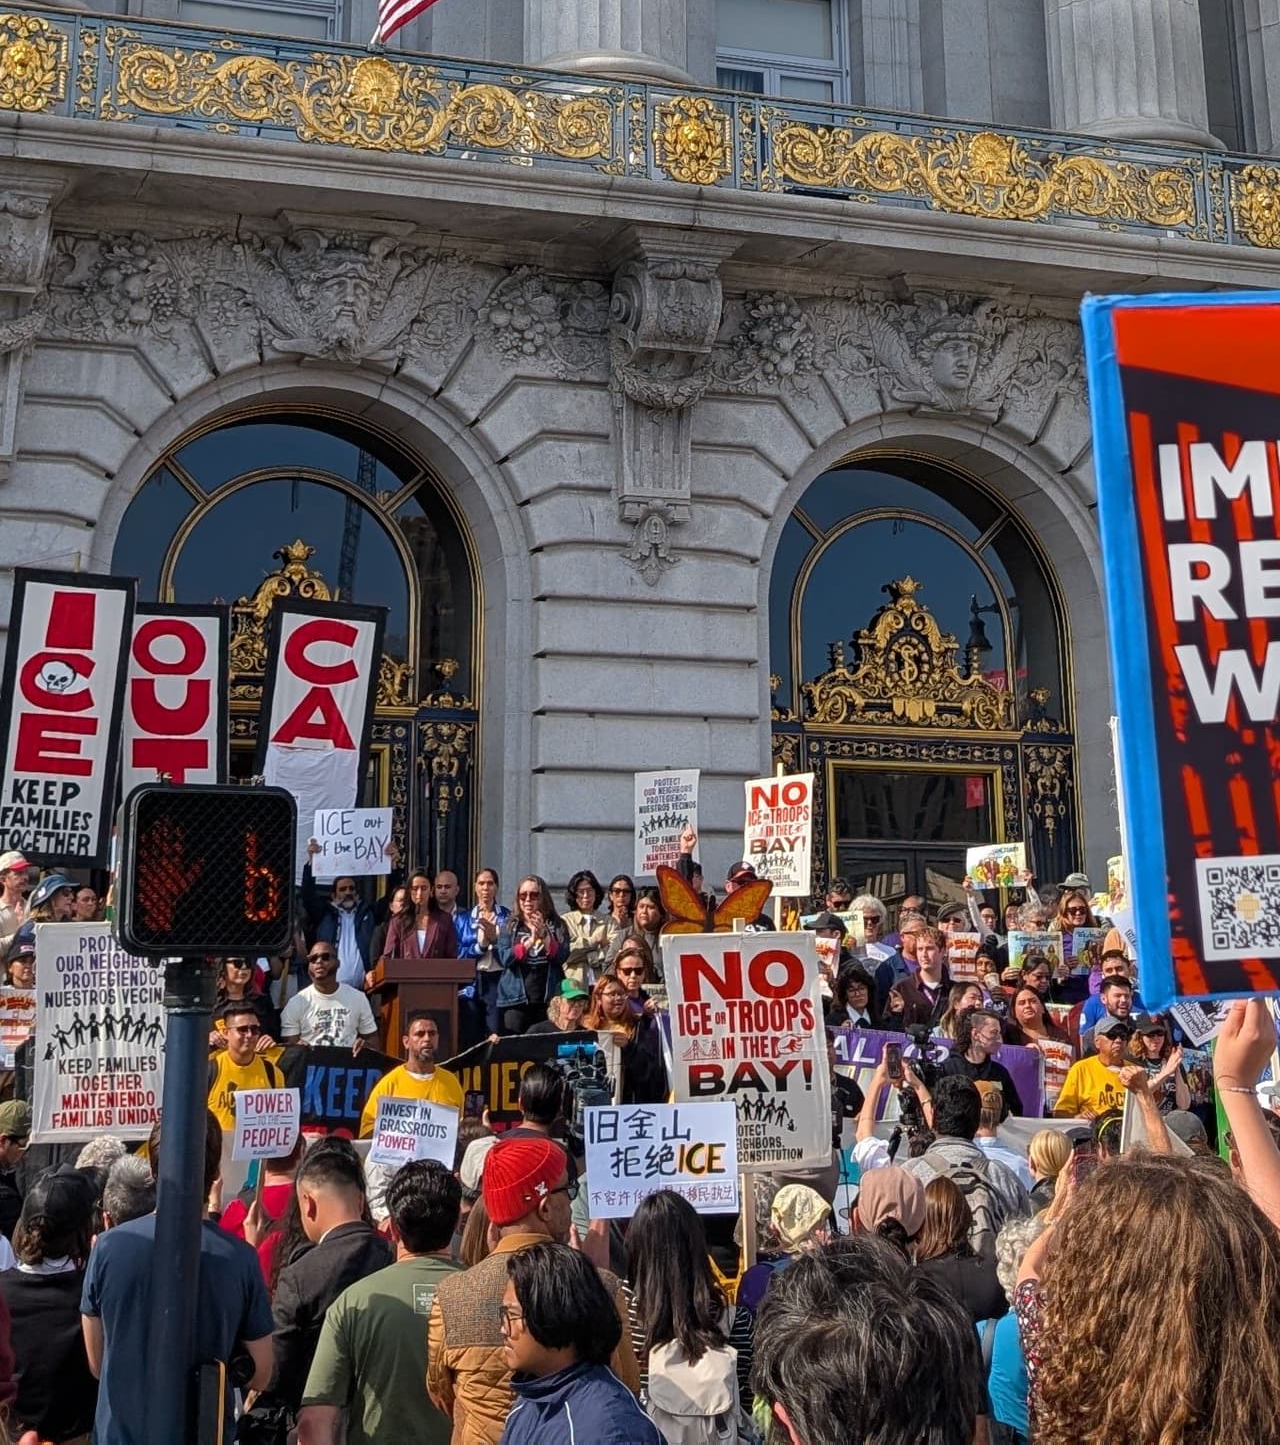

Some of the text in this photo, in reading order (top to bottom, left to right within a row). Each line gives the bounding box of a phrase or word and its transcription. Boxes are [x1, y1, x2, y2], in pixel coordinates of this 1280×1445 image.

[14, 591, 98, 777] ICE
[131, 619, 211, 783] OUT
[11, 778, 81, 806] KEEP
[643, 784, 693, 797] OUR NEIGHBORS
[654, 777, 681, 787] PROTECT
[646, 793, 687, 804] PROTEGIENDO
[751, 781, 808, 810] NO
[639, 801, 696, 814] NUESTROS VECINOS
[748, 810, 762, 826] ICE
[771, 805, 809, 825] TROOPS
[0, 806, 93, 831] FAMILIES
[321, 810, 384, 836] ICE out
[0, 828, 91, 856] TOGETHER
[334, 841, 352, 855] the
[354, 834, 388, 864] BAY
[645, 836, 659, 845] KEEP
[750, 835, 806, 855] BAY!
[80, 935, 123, 953] PROTE
[56, 956, 84, 973] OUR
[63, 970, 158, 990] PROTEGIENDO
[680, 950, 805, 1002] NO
[45, 990, 116, 1008] NUESTROS
[123, 987, 164, 1004] VECIN
[678, 998, 816, 1037] ICE OR TROOPS
[722, 1036, 770, 1060] IN THE
[59, 1056, 157, 1075] KEEP FAMILIES
[74, 1074, 142, 1092] TOGETHER
[688, 1059, 813, 1097] BAY!
[62, 1090, 155, 1110] MANTENIENDO
[244, 1093, 293, 1115] POWER
[52, 1110, 112, 1129] FAMILIAS
[257, 1115, 280, 1126] TO THE
[382, 1102, 431, 1121] INVEST IN
[380, 1119, 447, 1139] GRASSROOTS
[589, 1108, 691, 1144] 旧金山
[737, 1124, 767, 1137] OTECT
[242, 1127, 291, 1148] PEOPLE
[377, 1134, 416, 1152] POWER
[736, 1136, 785, 1150] EIGHBORS.
[737, 1148, 803, 1163] CONSTITUTION
